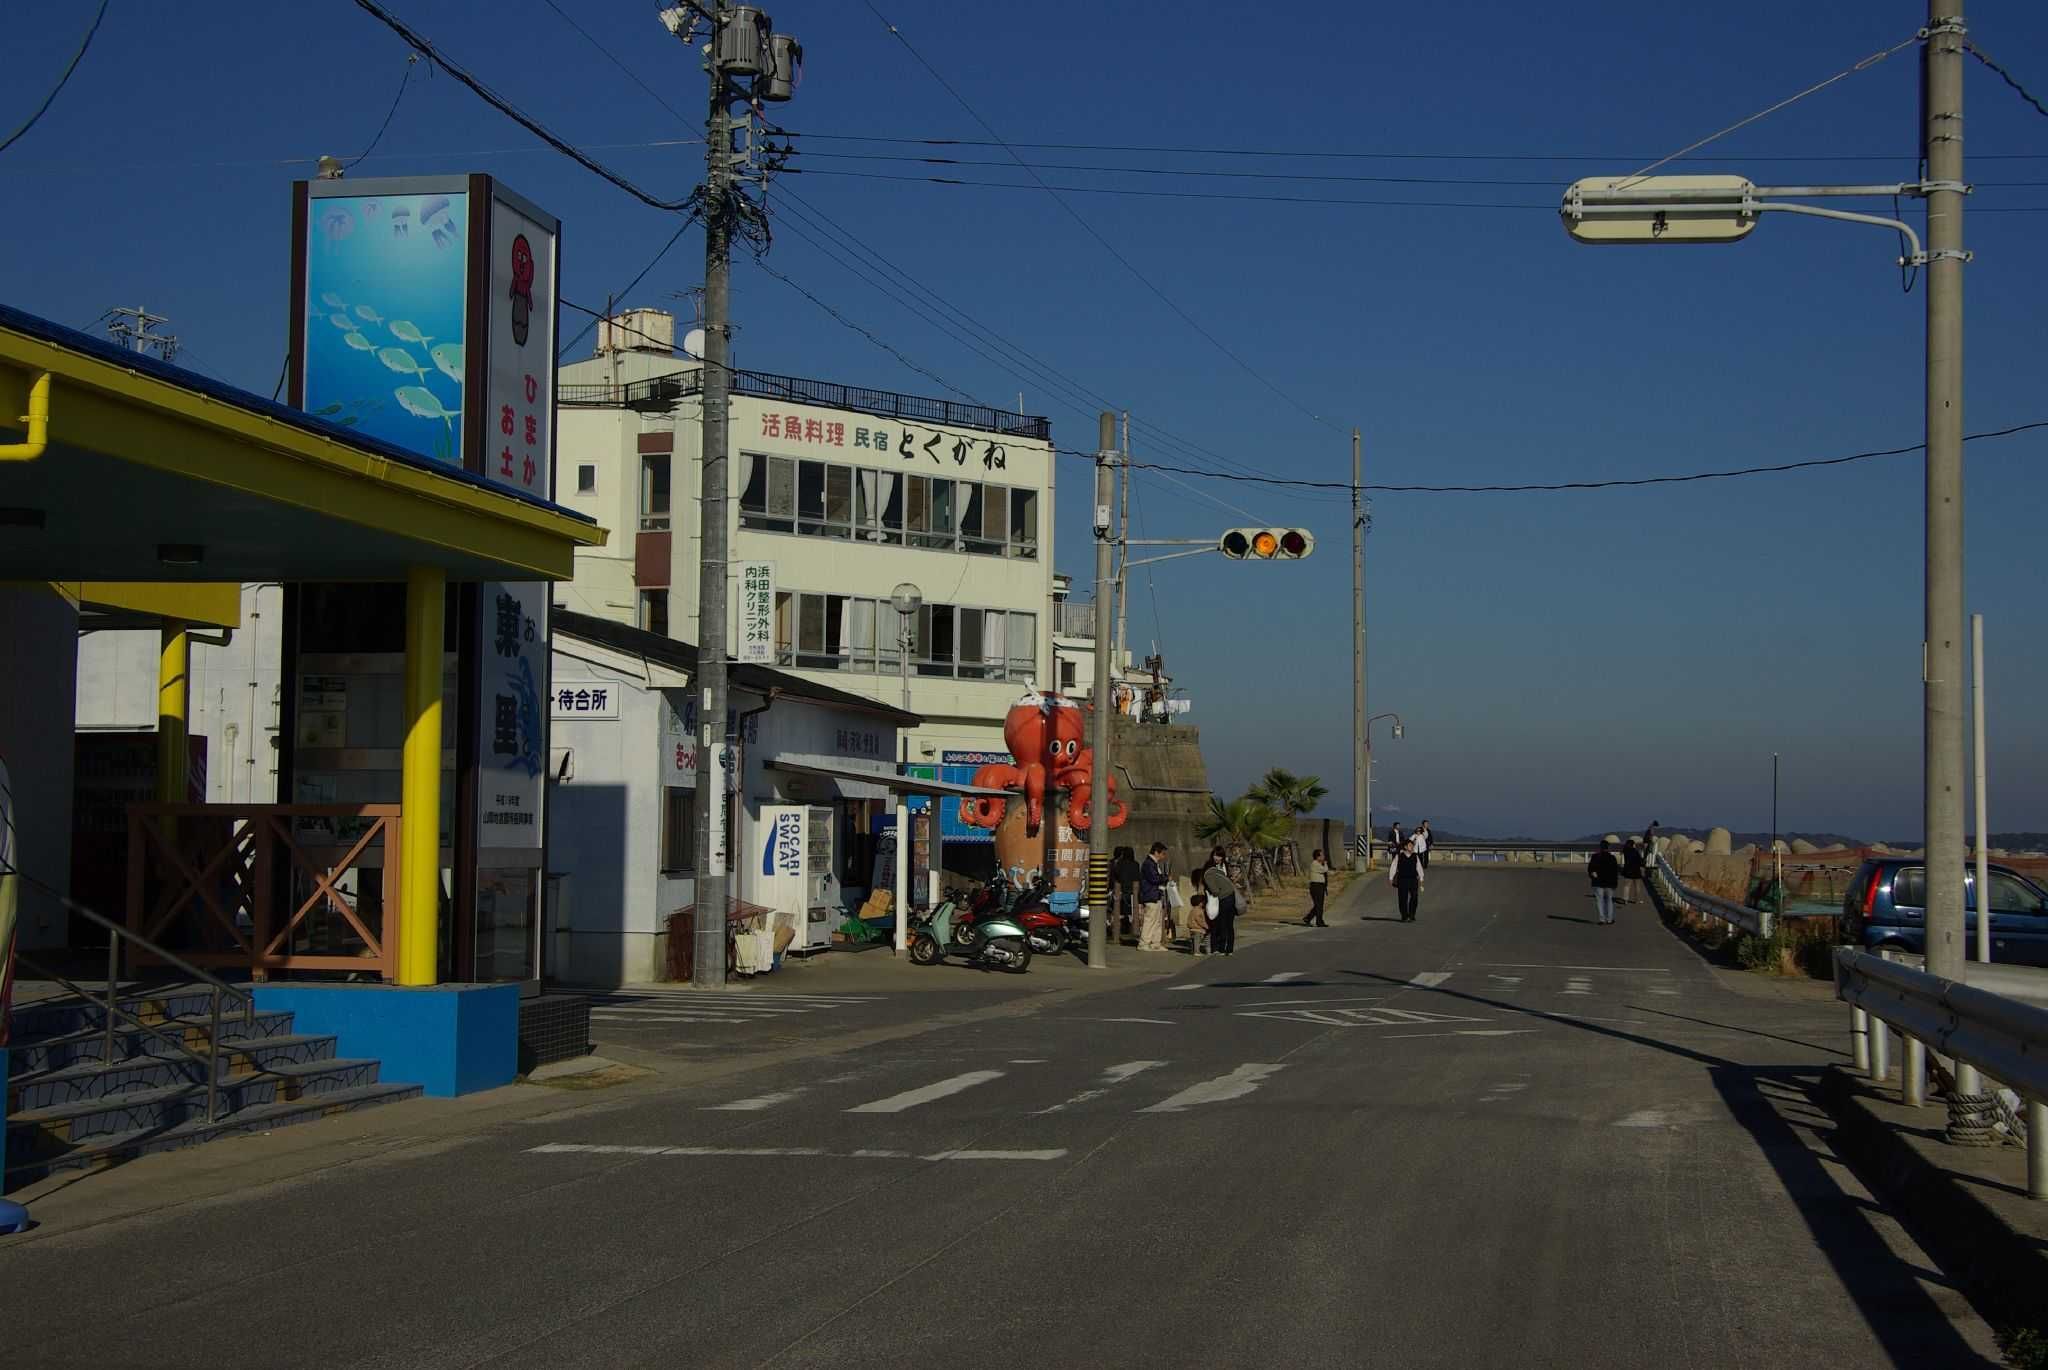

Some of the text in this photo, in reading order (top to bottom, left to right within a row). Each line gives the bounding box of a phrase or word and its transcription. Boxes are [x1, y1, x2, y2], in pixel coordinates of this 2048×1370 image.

[761, 412, 1006, 471] 活魚料理 民宿 とくがね
[745, 566, 758, 642] 内科クリニック
[757, 566, 770, 642] 浜田整形外科
[779, 813, 790, 870] SWEAT
[790, 813, 801, 876] POCARI
